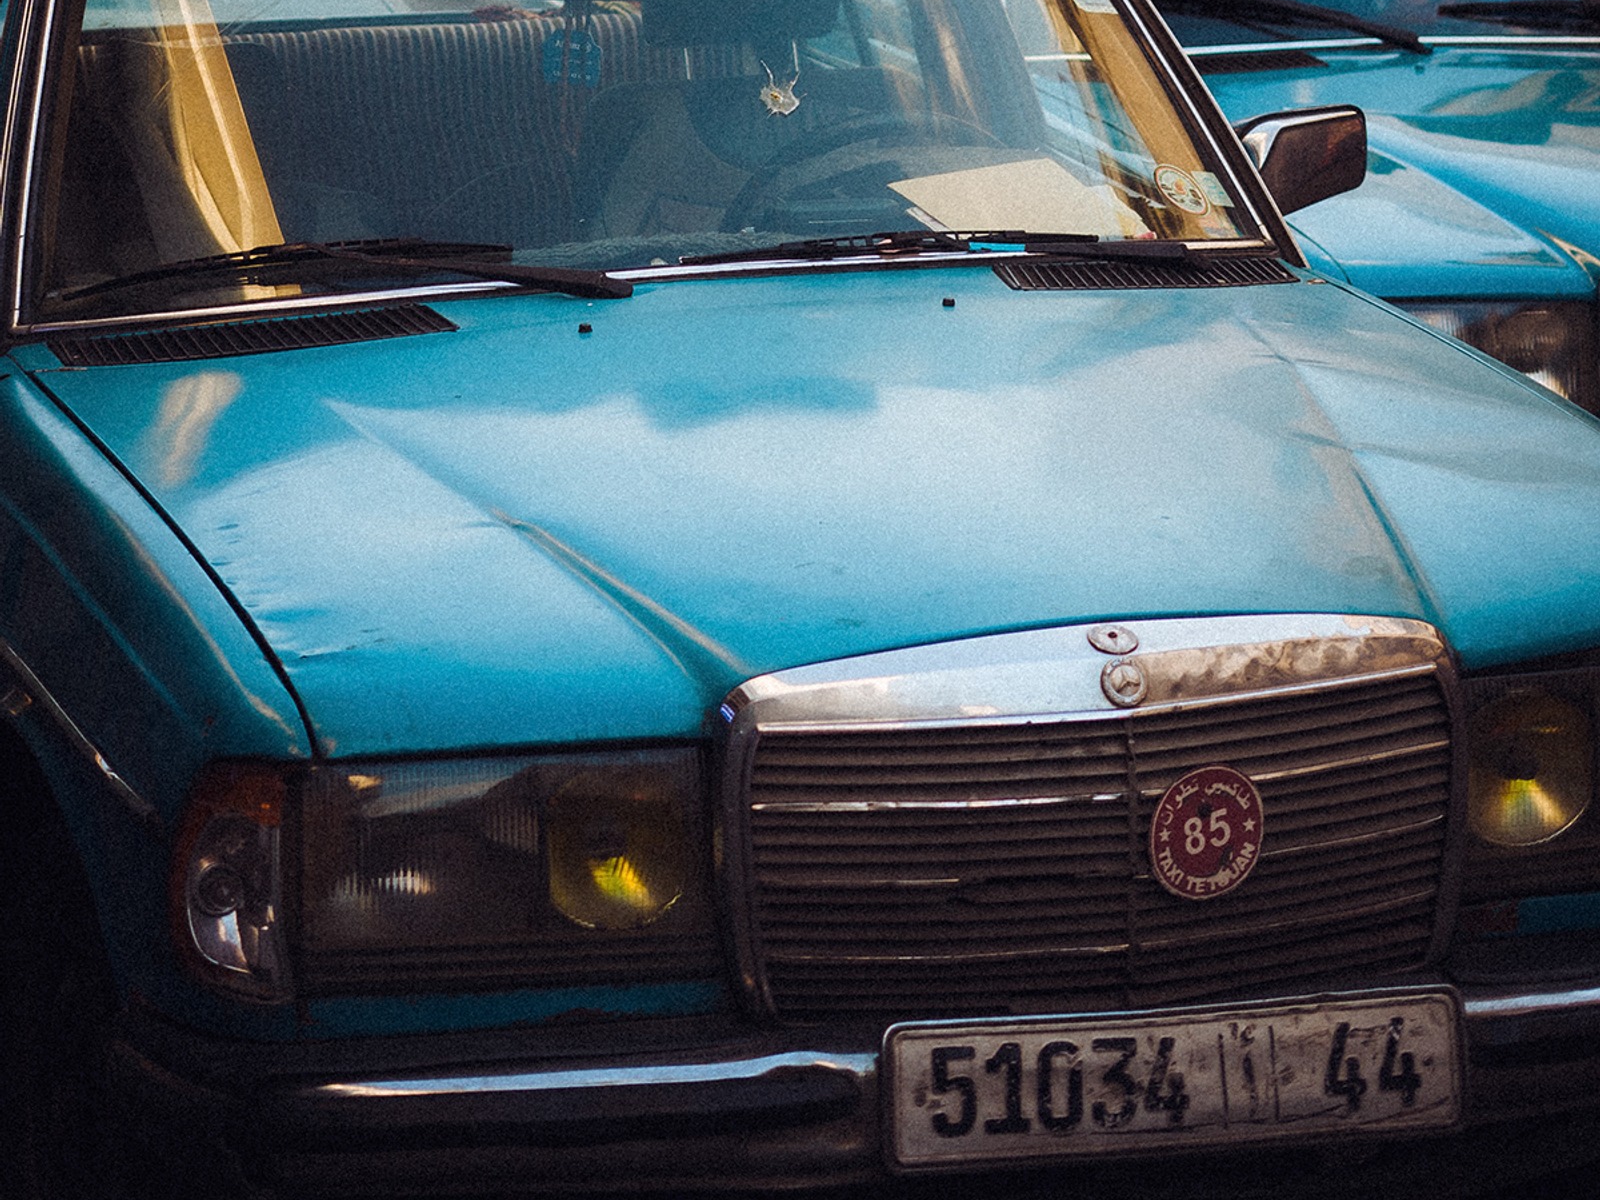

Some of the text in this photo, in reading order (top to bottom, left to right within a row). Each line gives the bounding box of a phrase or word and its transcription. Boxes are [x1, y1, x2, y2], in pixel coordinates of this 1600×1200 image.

[1183, 807, 1232, 856] 85
[1158, 846, 1185, 885] TAXI
[930, 1036, 1190, 1139] 51034
[1324, 1017, 1422, 1112] 44
